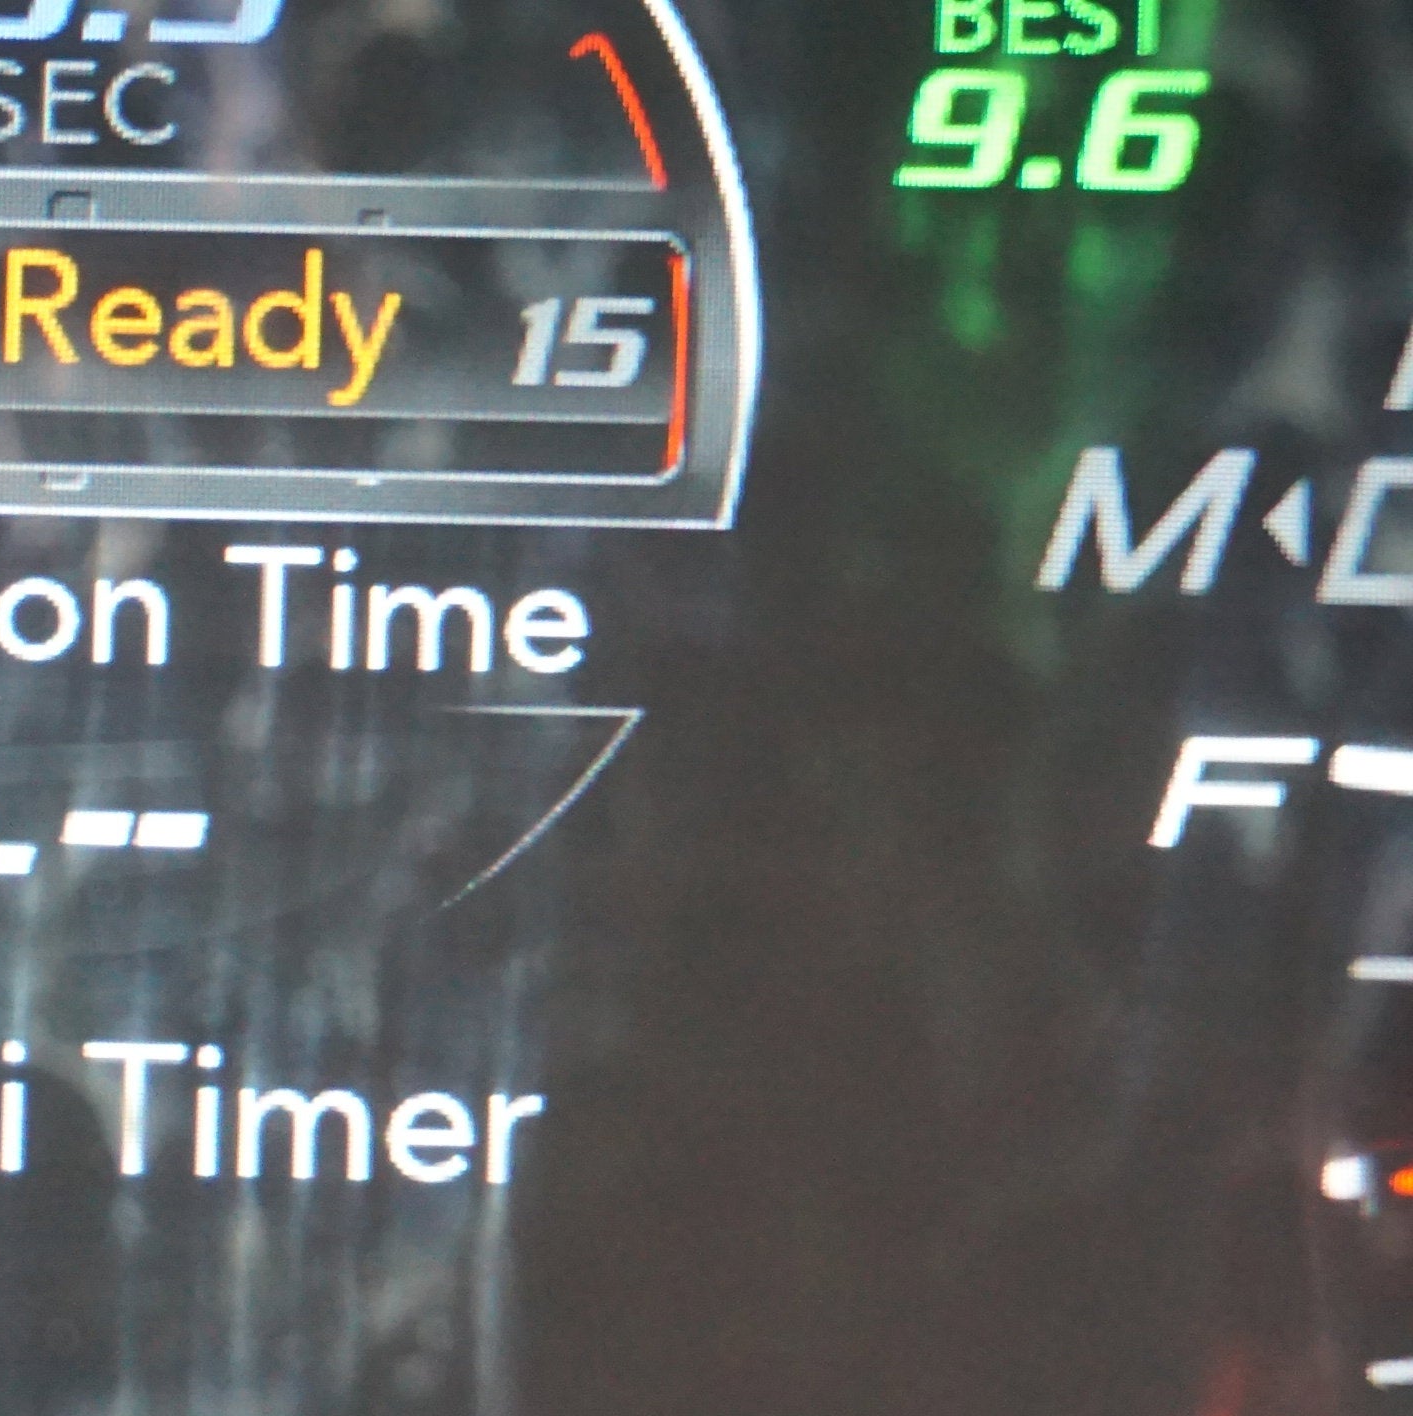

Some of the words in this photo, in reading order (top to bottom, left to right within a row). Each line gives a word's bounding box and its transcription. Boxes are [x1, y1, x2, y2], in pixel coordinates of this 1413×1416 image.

[893, 68, 1210, 191] 9.6
[3, 247, 401, 407] Ready
[510, 296, 654, 388] 15
[224, 545, 591, 675] Time
[1147, 735, 1319, 849] F
[82, 1041, 545, 1186] Timer
